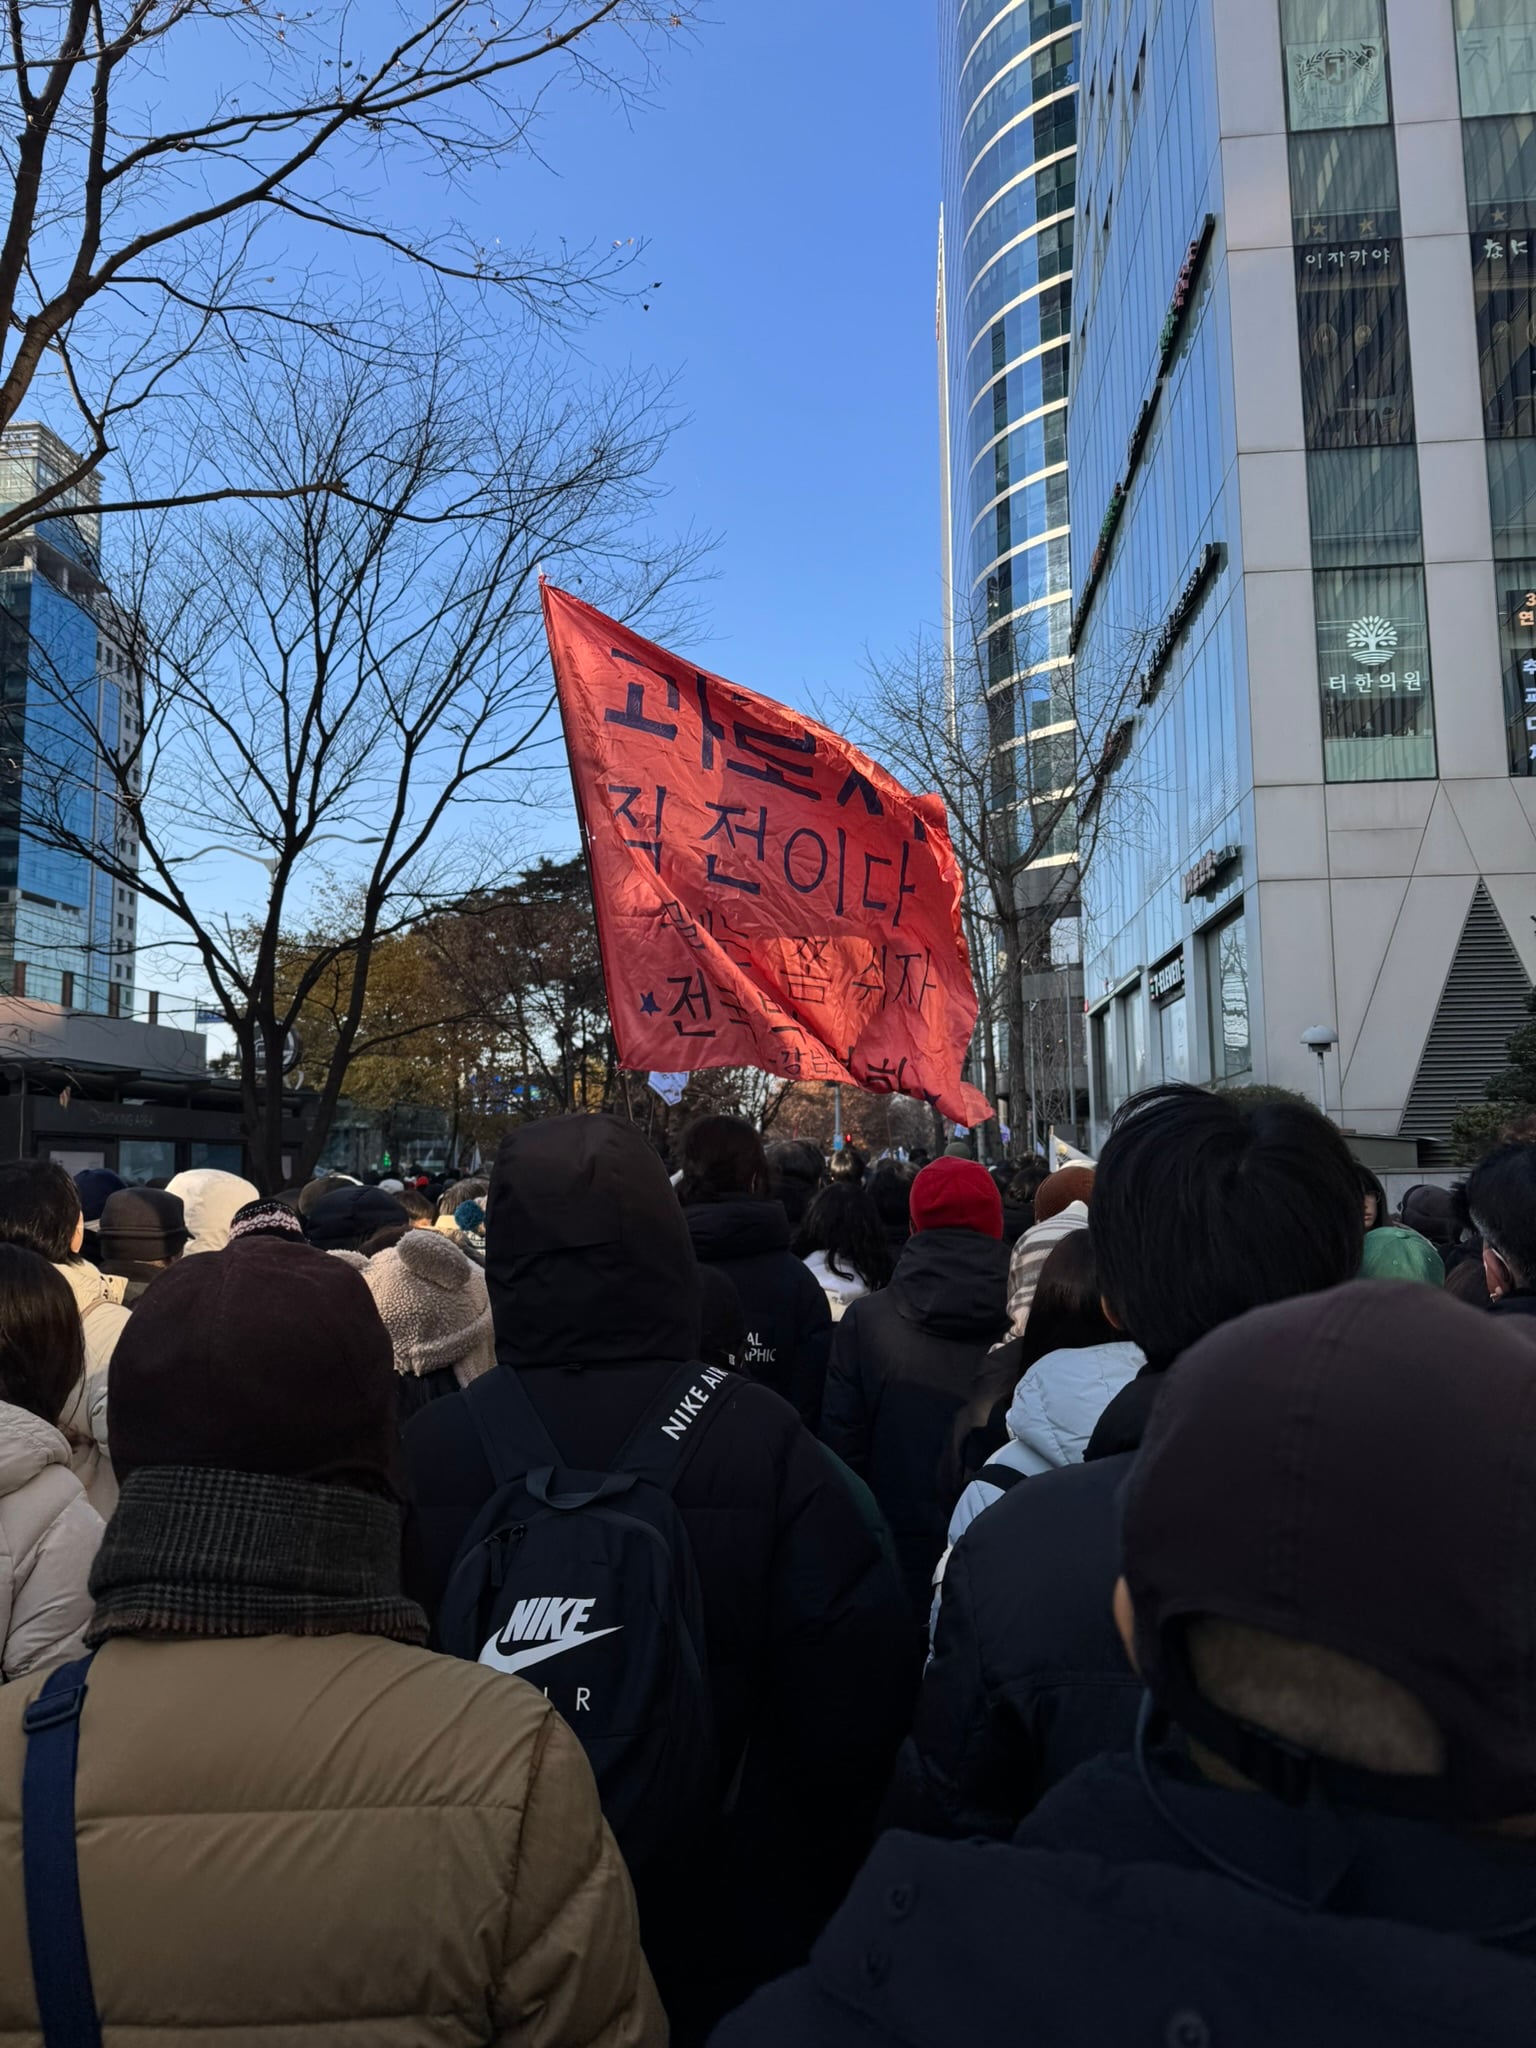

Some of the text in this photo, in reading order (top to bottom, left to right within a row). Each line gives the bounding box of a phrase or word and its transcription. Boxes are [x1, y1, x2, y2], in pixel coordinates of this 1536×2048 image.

[1305, 247, 1391, 269] 이자카야
[1328, 670, 1422, 694] 터한의원
[607, 784, 917, 928] 직전이다
[780, 935, 833, 1005] 쫌
[852, 944, 937, 1012] 쉬자
[661, 1386, 709, 1440] NIKE
[500, 1597, 596, 1643] NIKE
